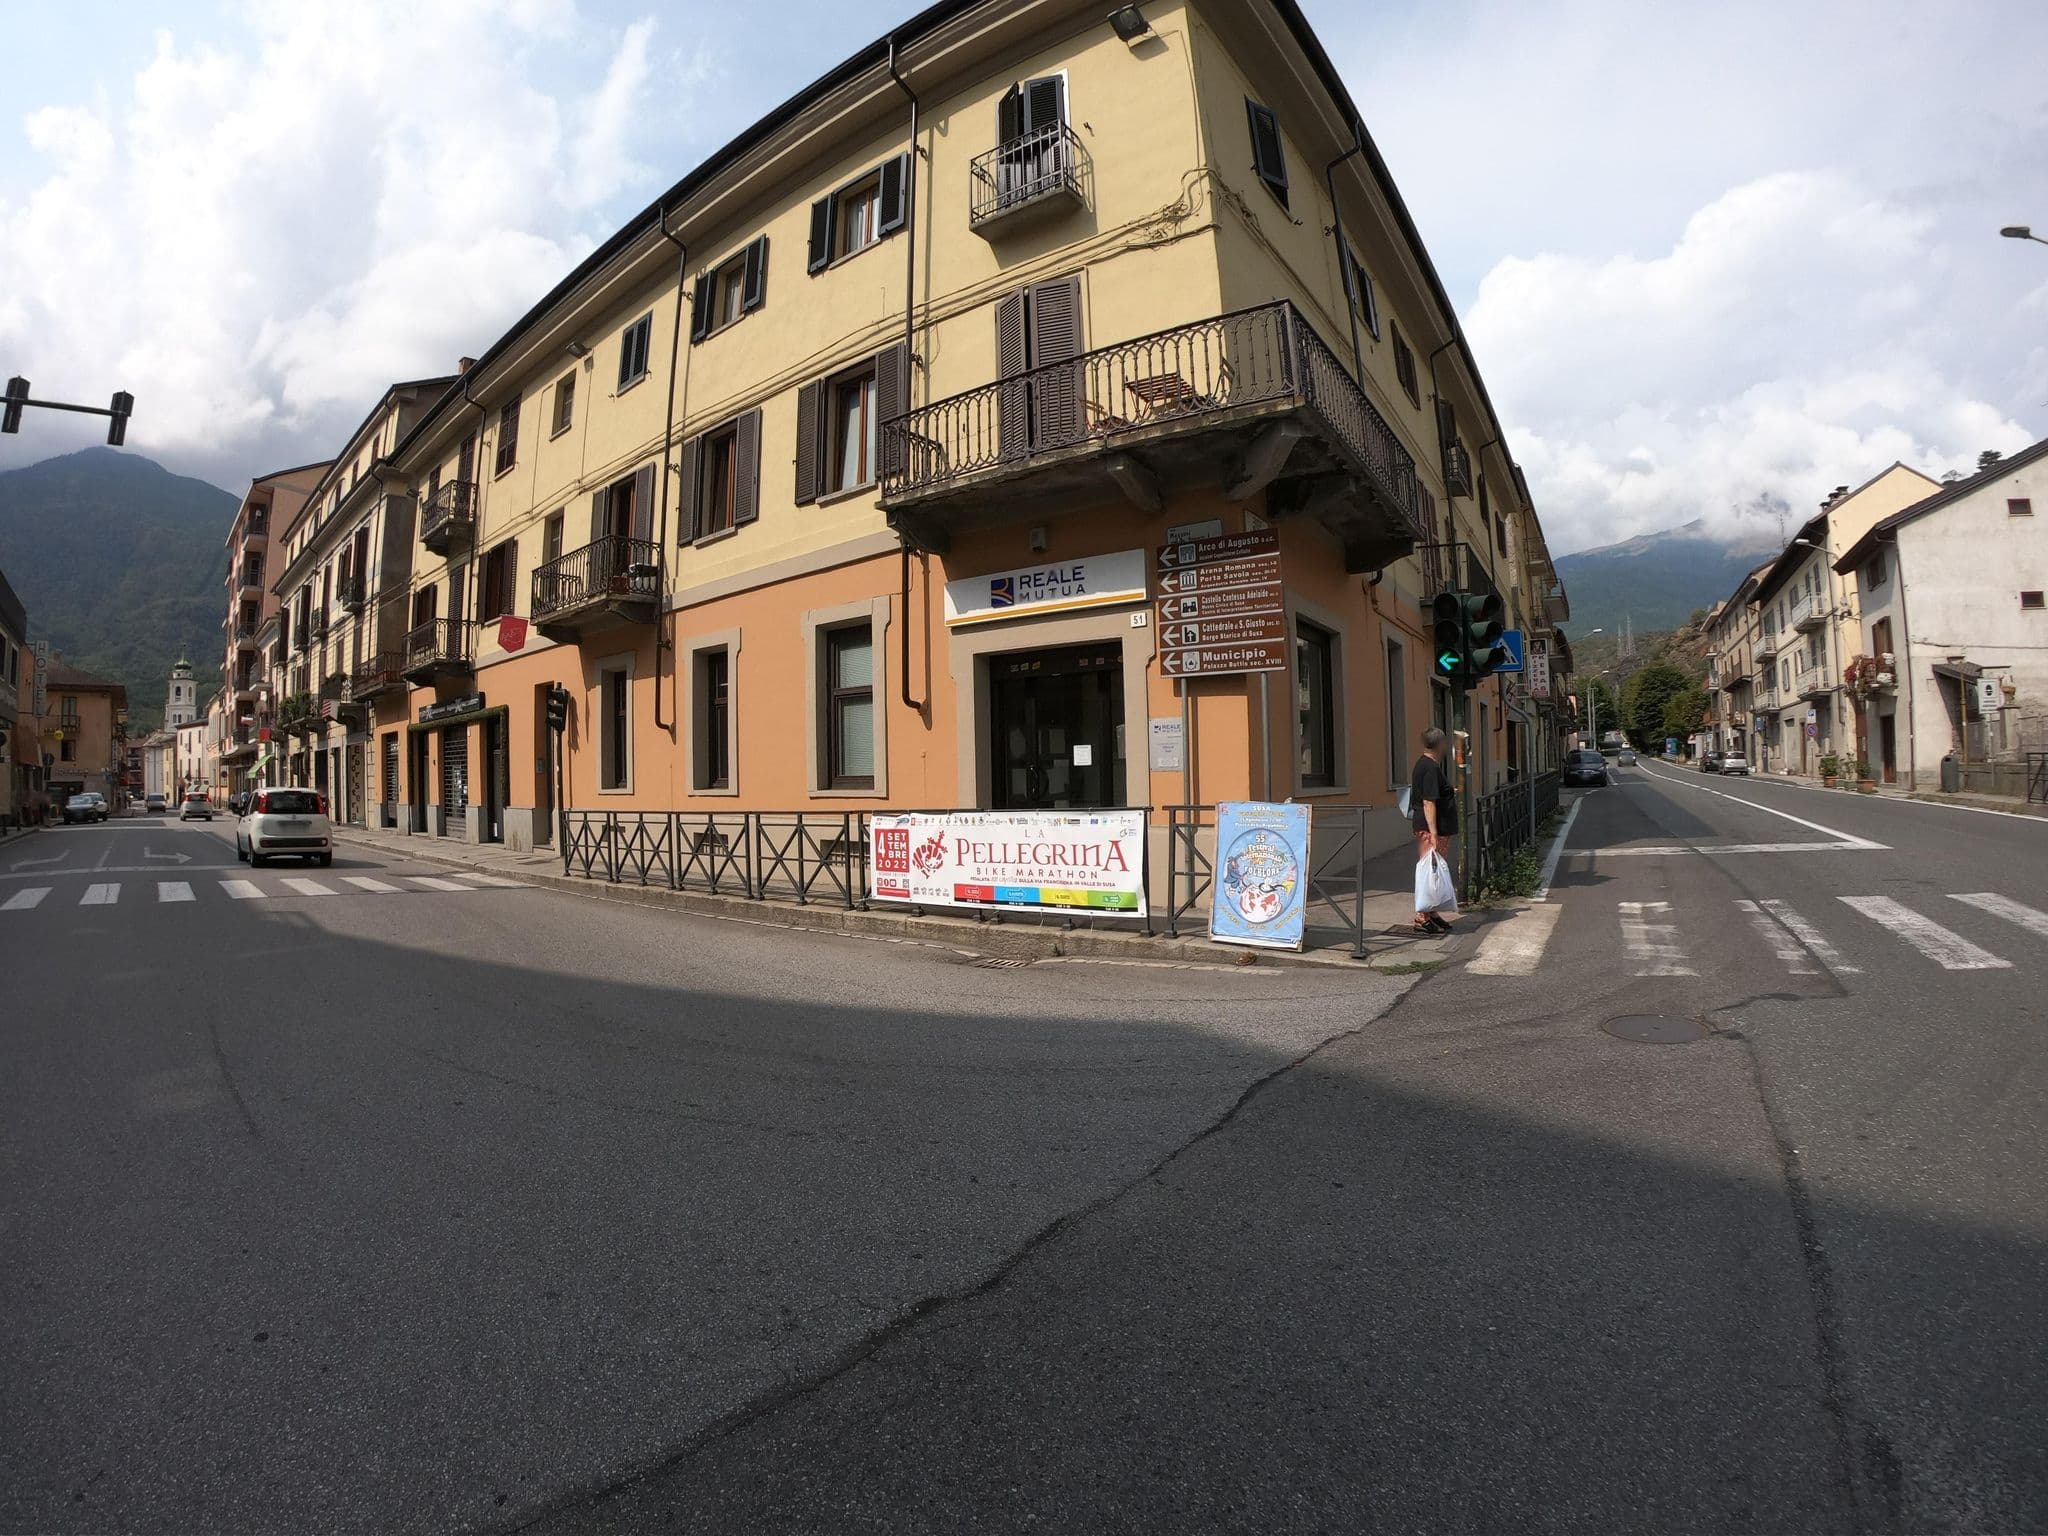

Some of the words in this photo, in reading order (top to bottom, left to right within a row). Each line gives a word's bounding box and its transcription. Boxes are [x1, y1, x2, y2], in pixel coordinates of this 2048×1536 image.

[1198, 544, 1216, 552] Arco
[1218, 541, 1225, 549] di
[1228, 536, 1259, 548] Augusto
[1200, 567, 1222, 575] Arena
[1225, 563, 1256, 572] Romana
[1019, 565, 1085, 589] REALE
[1200, 574, 1221, 582] Porta
[1223, 571, 1250, 580] Savoia
[1019, 583, 1086, 602] MUTUA
[1202, 595, 1221, 605] Castello
[1222, 592, 1245, 601] Contessa
[1246, 590, 1269, 599] Adelaide
[1133, 615, 1143, 625] 51
[1202, 621, 1233, 632] Cattedrale
[1239, 620, 1245, 629] S.
[1246, 619, 1265, 628] Giusto
[1202, 633, 1218, 641] Borgo
[1220, 631, 1240, 639] Storico
[1202, 648, 1266, 661] Municipio
[888, 833, 906, 841] SET
[1025, 829, 1045, 838] LA
[878, 832, 885, 858] 4
[888, 842, 907, 850] TEM
[889, 851, 907, 859] BRE
[955, 838, 1130, 872] PELLEGRINA
[878, 860, 907, 869] 2022
[976, 867, 1006, 876] BIKE
[1017, 869, 1098, 879] MARATHON
